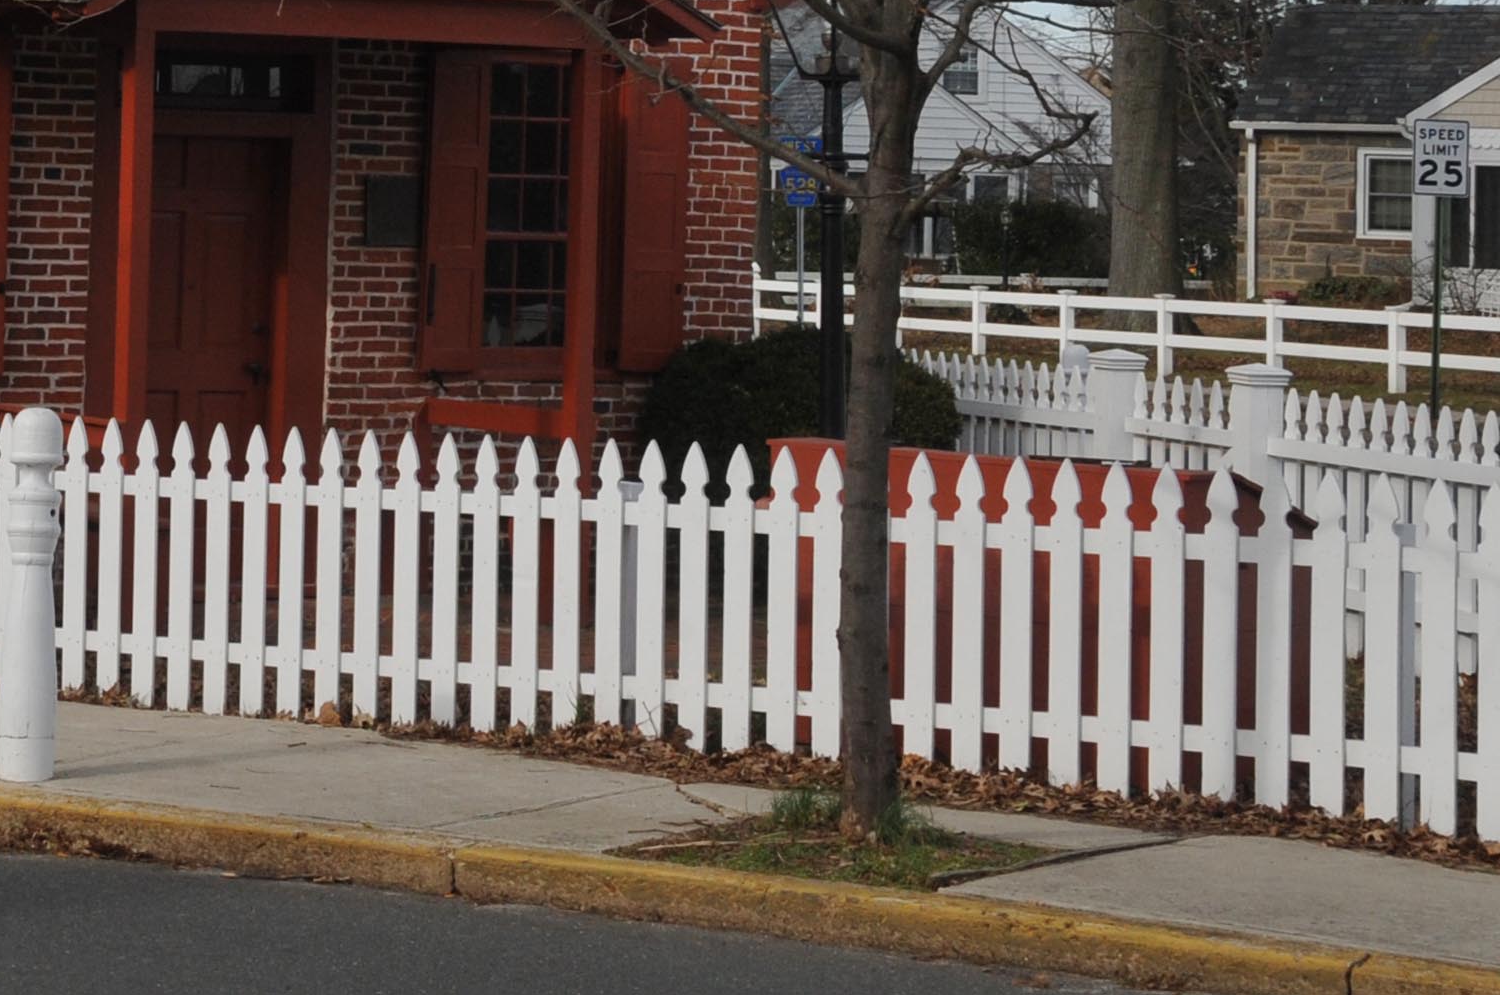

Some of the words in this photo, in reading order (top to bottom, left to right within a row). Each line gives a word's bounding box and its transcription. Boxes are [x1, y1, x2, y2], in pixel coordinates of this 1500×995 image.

[1419, 128, 1465, 141] SPEED
[1422, 144, 1460, 156] LIMIT
[1418, 159, 1463, 187] 25
